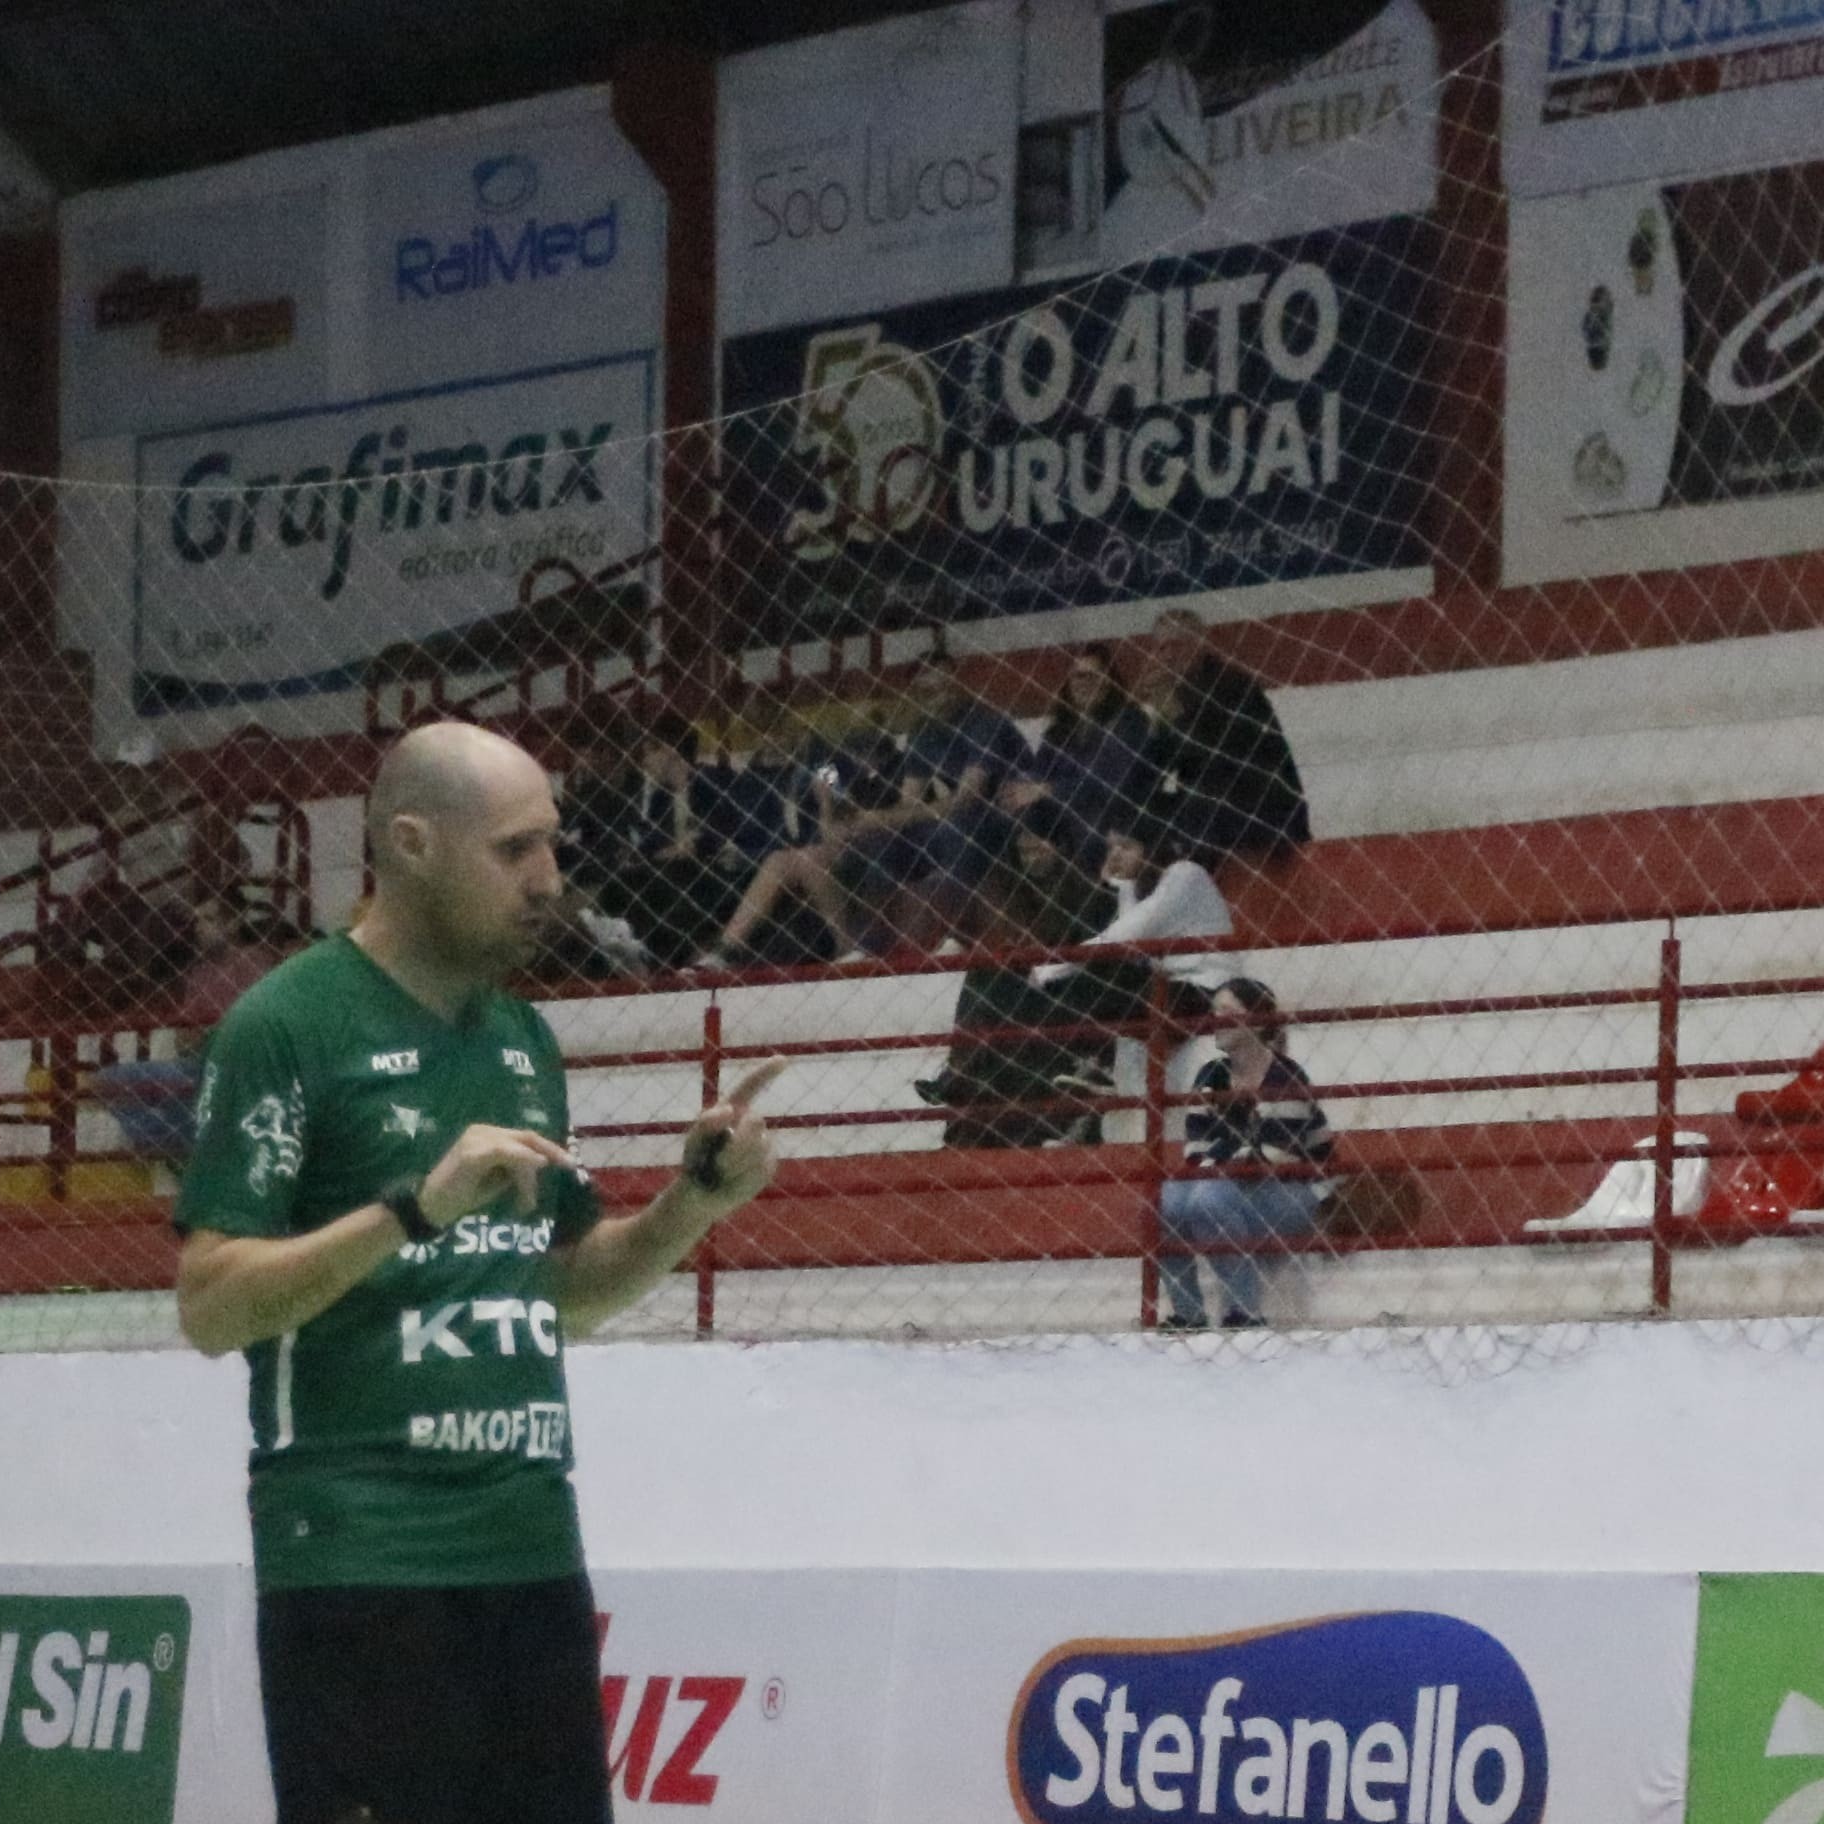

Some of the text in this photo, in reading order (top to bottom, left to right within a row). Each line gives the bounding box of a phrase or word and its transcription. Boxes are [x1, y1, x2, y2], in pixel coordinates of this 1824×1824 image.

[1000, 262, 1340, 425] O ALTO
[172, 422, 615, 602] Grafimax
[959, 390, 1342, 533] URUGUAI
